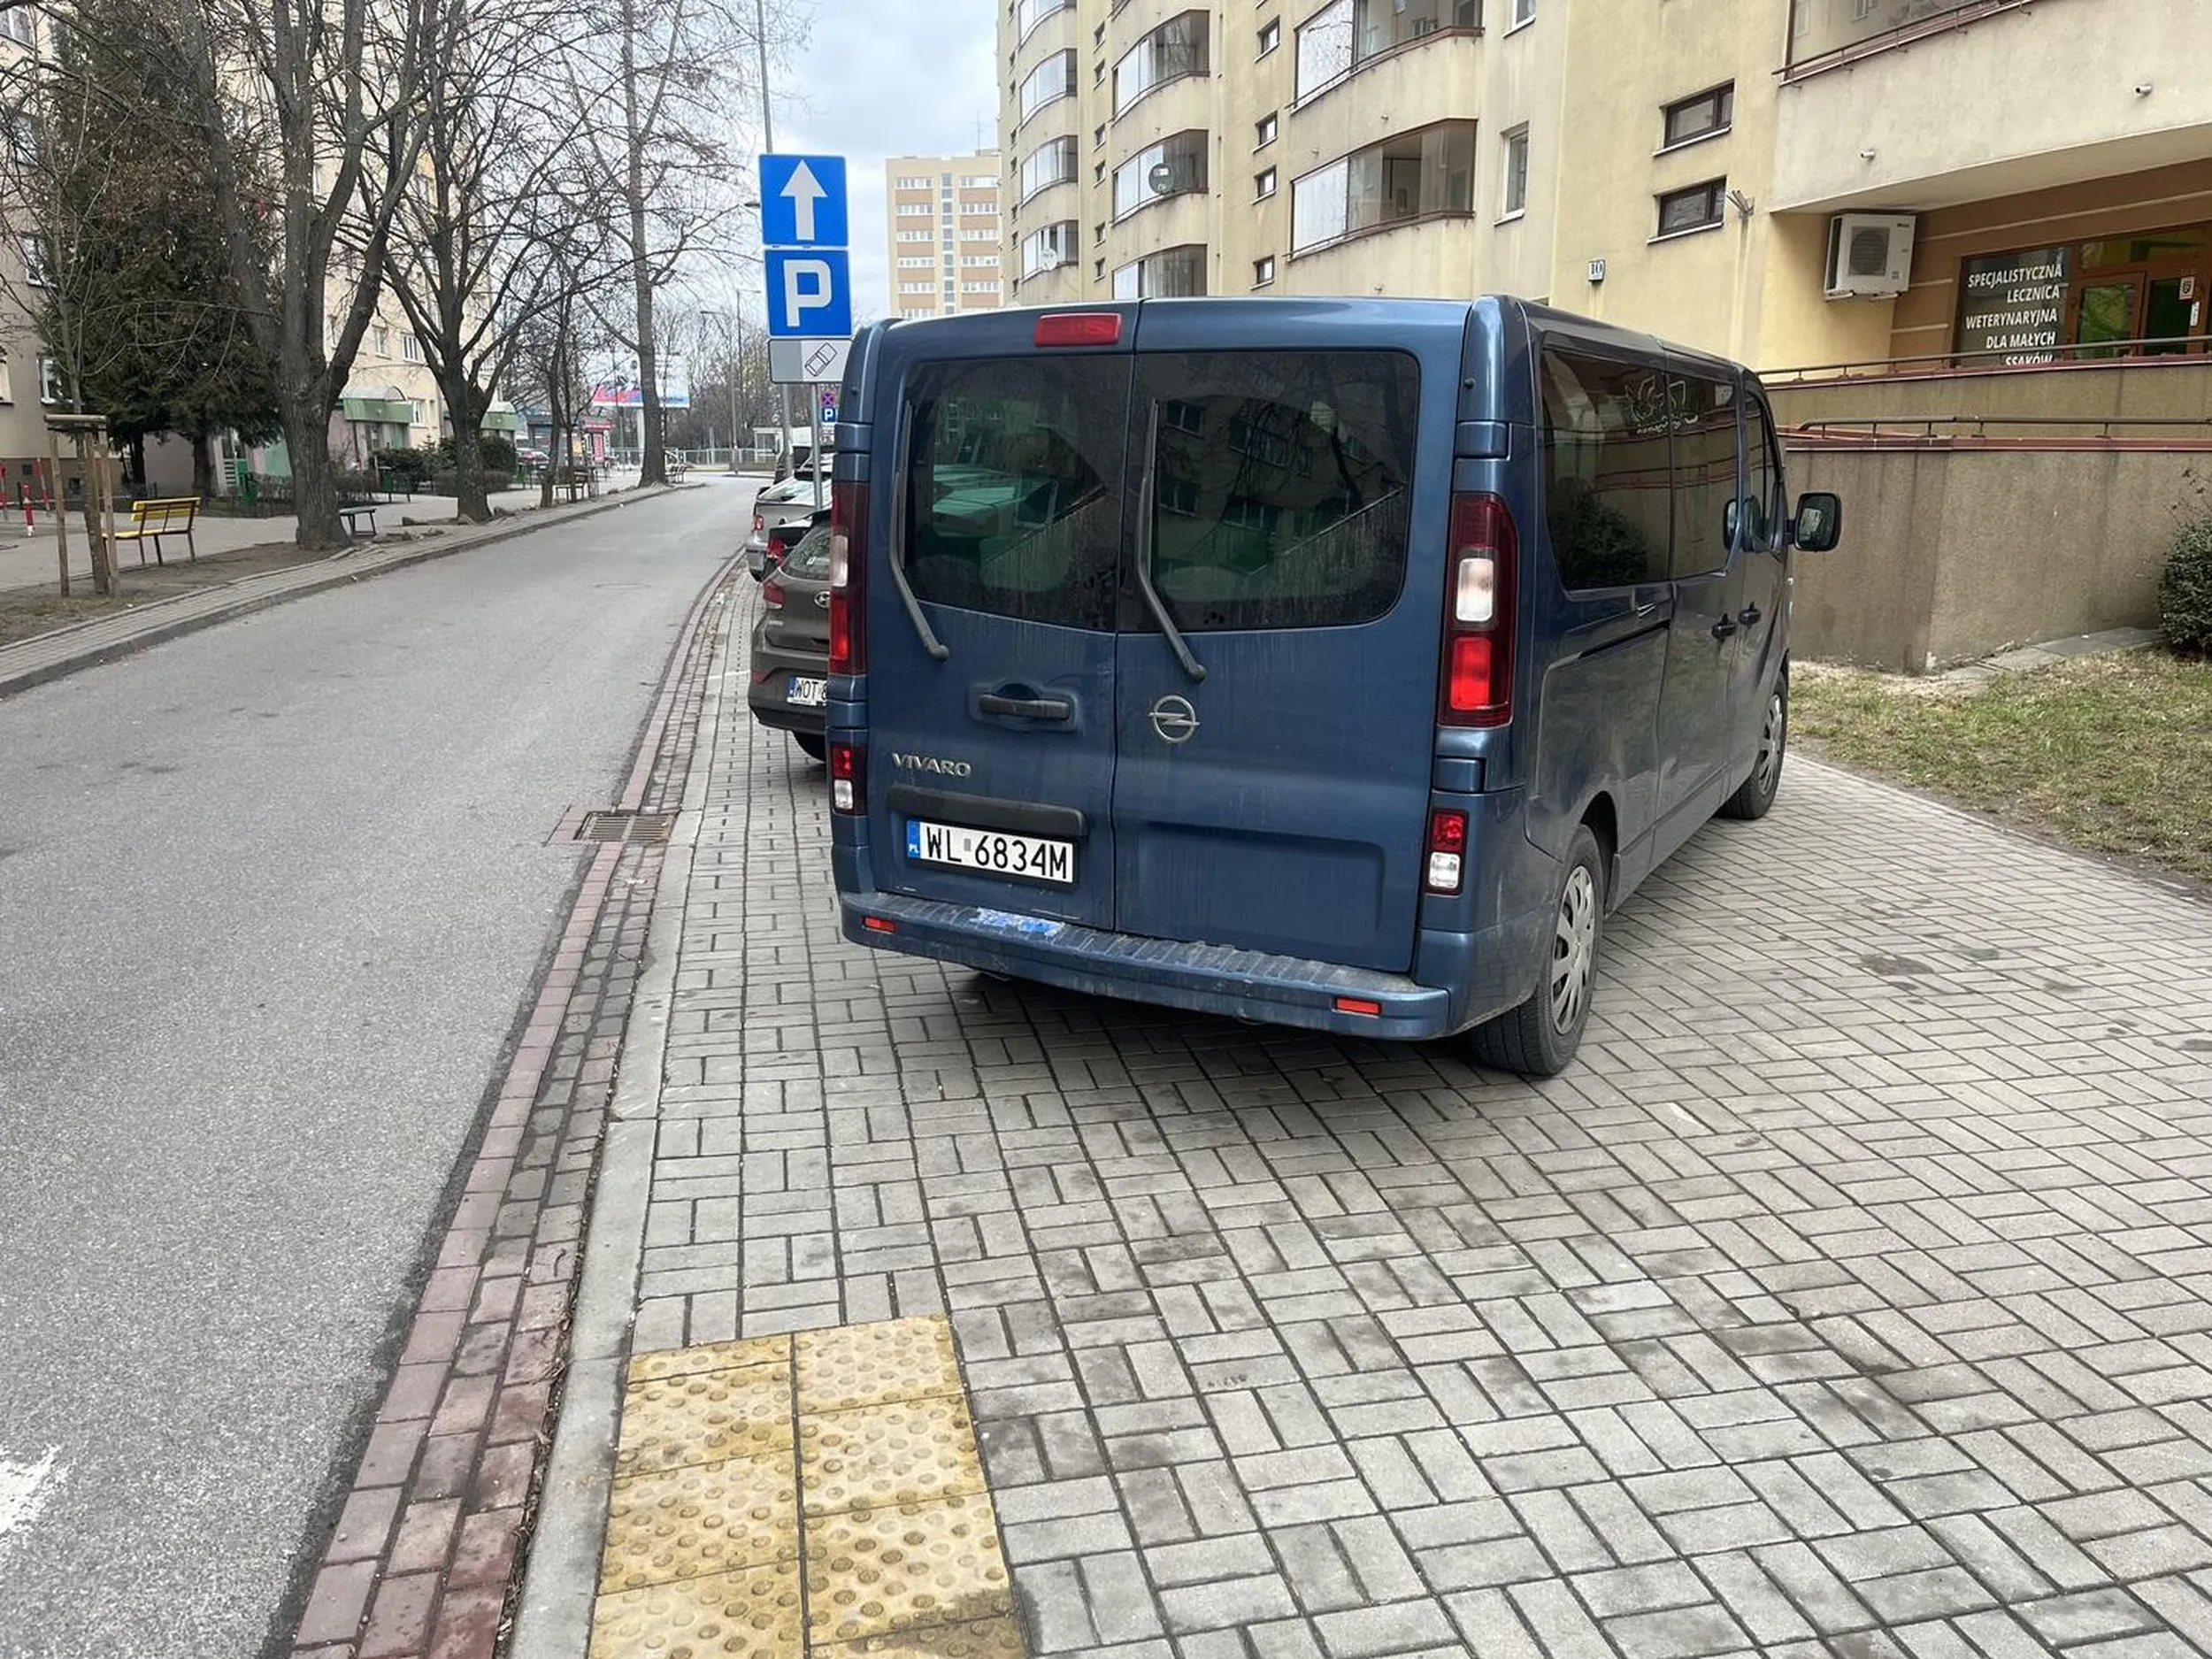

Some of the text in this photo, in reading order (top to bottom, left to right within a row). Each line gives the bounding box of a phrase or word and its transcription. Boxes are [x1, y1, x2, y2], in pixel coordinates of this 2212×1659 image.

[1591, 264, 1602, 274] 10
[1968, 264, 2062, 288] SPECJALISTYCZNA
[784, 259, 832, 326] P
[2007, 285, 2060, 303] LECZNICA
[1966, 308, 2057, 329] WETERYNARYJNA
[1985, 331, 2055, 349] DLA MAŁYCH
[825, 408, 833, 420] P
[795, 680, 818, 699] WOT
[892, 752, 972, 777] VIVARO
[909, 843, 919, 854] PL
[926, 826, 1066, 879] WL 6834M
